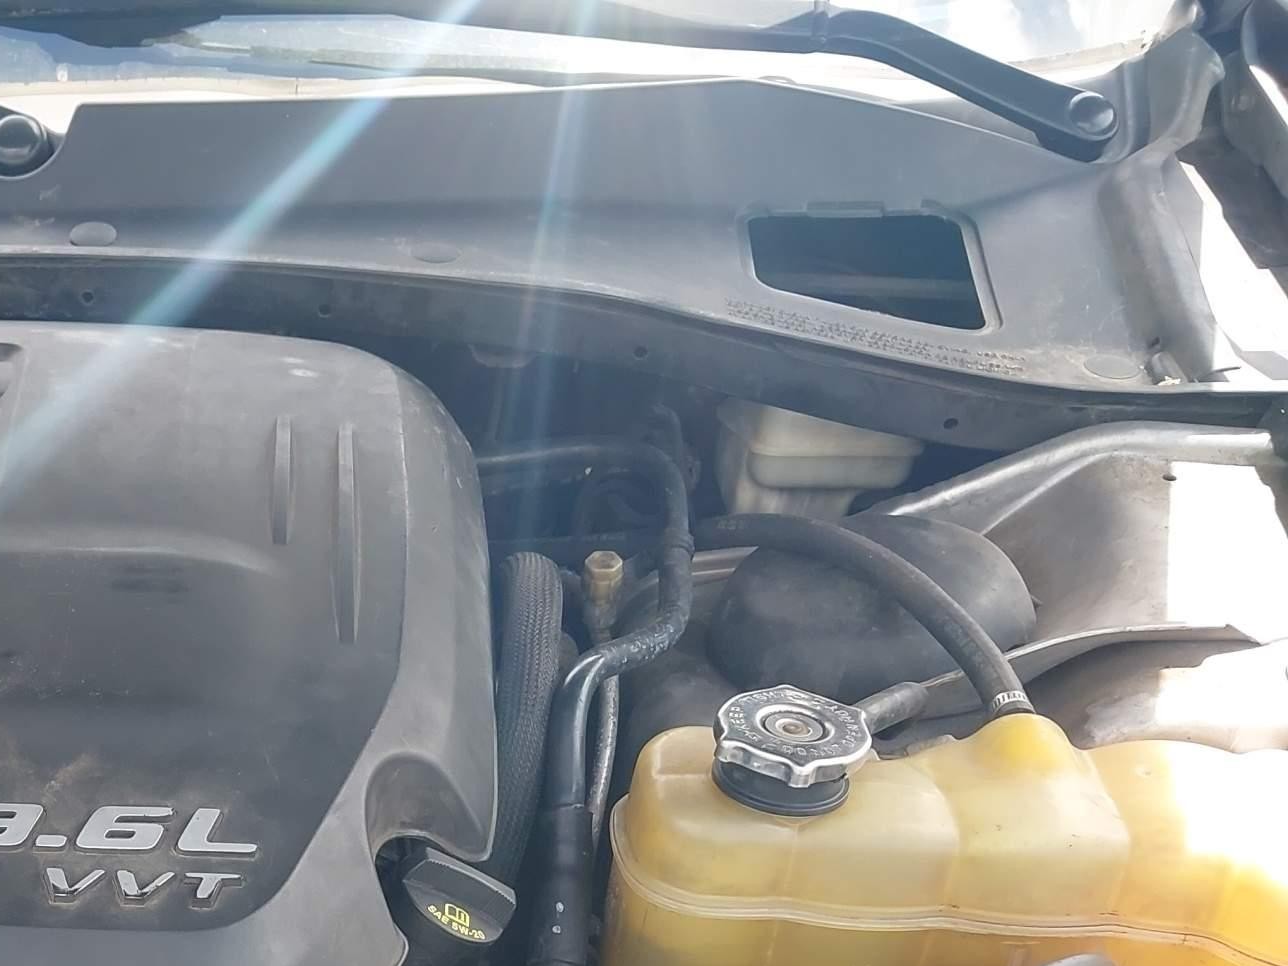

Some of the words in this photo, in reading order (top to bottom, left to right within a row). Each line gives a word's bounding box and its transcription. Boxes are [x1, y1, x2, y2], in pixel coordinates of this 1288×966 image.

[45, 867, 243, 908] VVT
[428, 904, 449, 925] SAE
[451, 923, 486, 940] 5W-20
